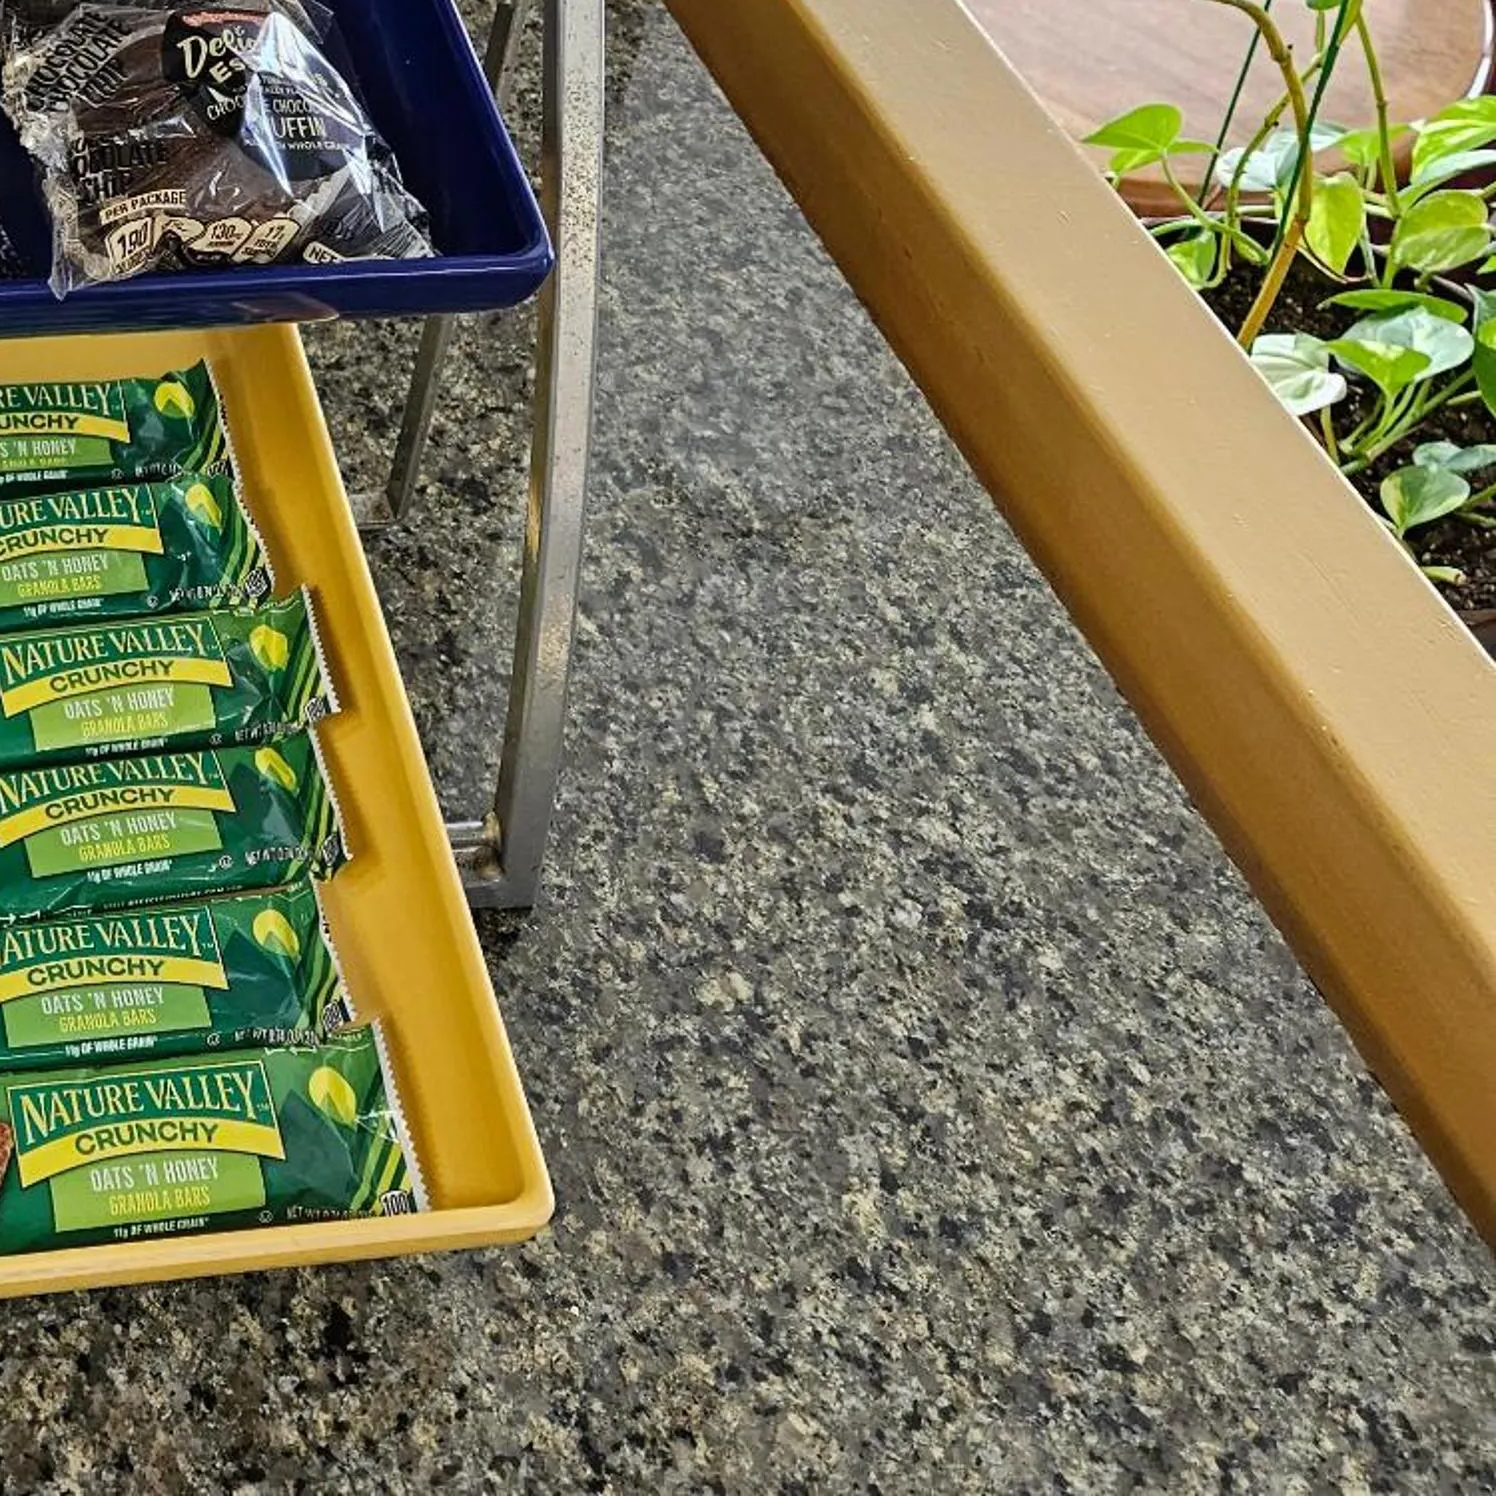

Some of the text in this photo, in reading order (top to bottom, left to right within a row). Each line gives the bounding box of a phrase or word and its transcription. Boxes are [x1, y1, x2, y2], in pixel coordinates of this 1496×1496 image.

[105, 191, 186, 220] PER PACKAGE
[117, 220, 150, 259] 190
[25, 382, 111, 416] VALLEY
[33, 438, 77, 455] HONEY
[52, 485, 141, 523] VALLEY
[1, 560, 39, 582] OATS
[63, 553, 109, 573] HONEY
[2, 623, 207, 686] NATURE VALLEY
[49, 659, 175, 694] CRUNCHY
[64, 697, 101, 720] OATS
[128, 687, 175, 711] HONEY
[106, 750, 208, 787] VALLEY
[45, 786, 176, 821] CRUNCHY
[60, 822, 101, 846] OATS
[127, 811, 177, 835] HONEY
[79, 841, 137, 862] GRANOLA
[98, 914, 204, 959] VALLEY
[26, 957, 166, 987] CRUNCHY
[41, 994, 84, 1015] OATS
[111, 986, 165, 1007] HONEY
[58, 1012, 119, 1034] GRANOLA
[18, 1067, 257, 1146] NATURE VALLEY
[75, 1120, 220, 1156] CRUNCHY
[90, 1165, 135, 1193] OATS
[164, 1156, 218, 1181] HONEY
[108, 1185, 211, 1216] GRANOLA BARS
[144, 1220, 176, 1236] WHOLE
